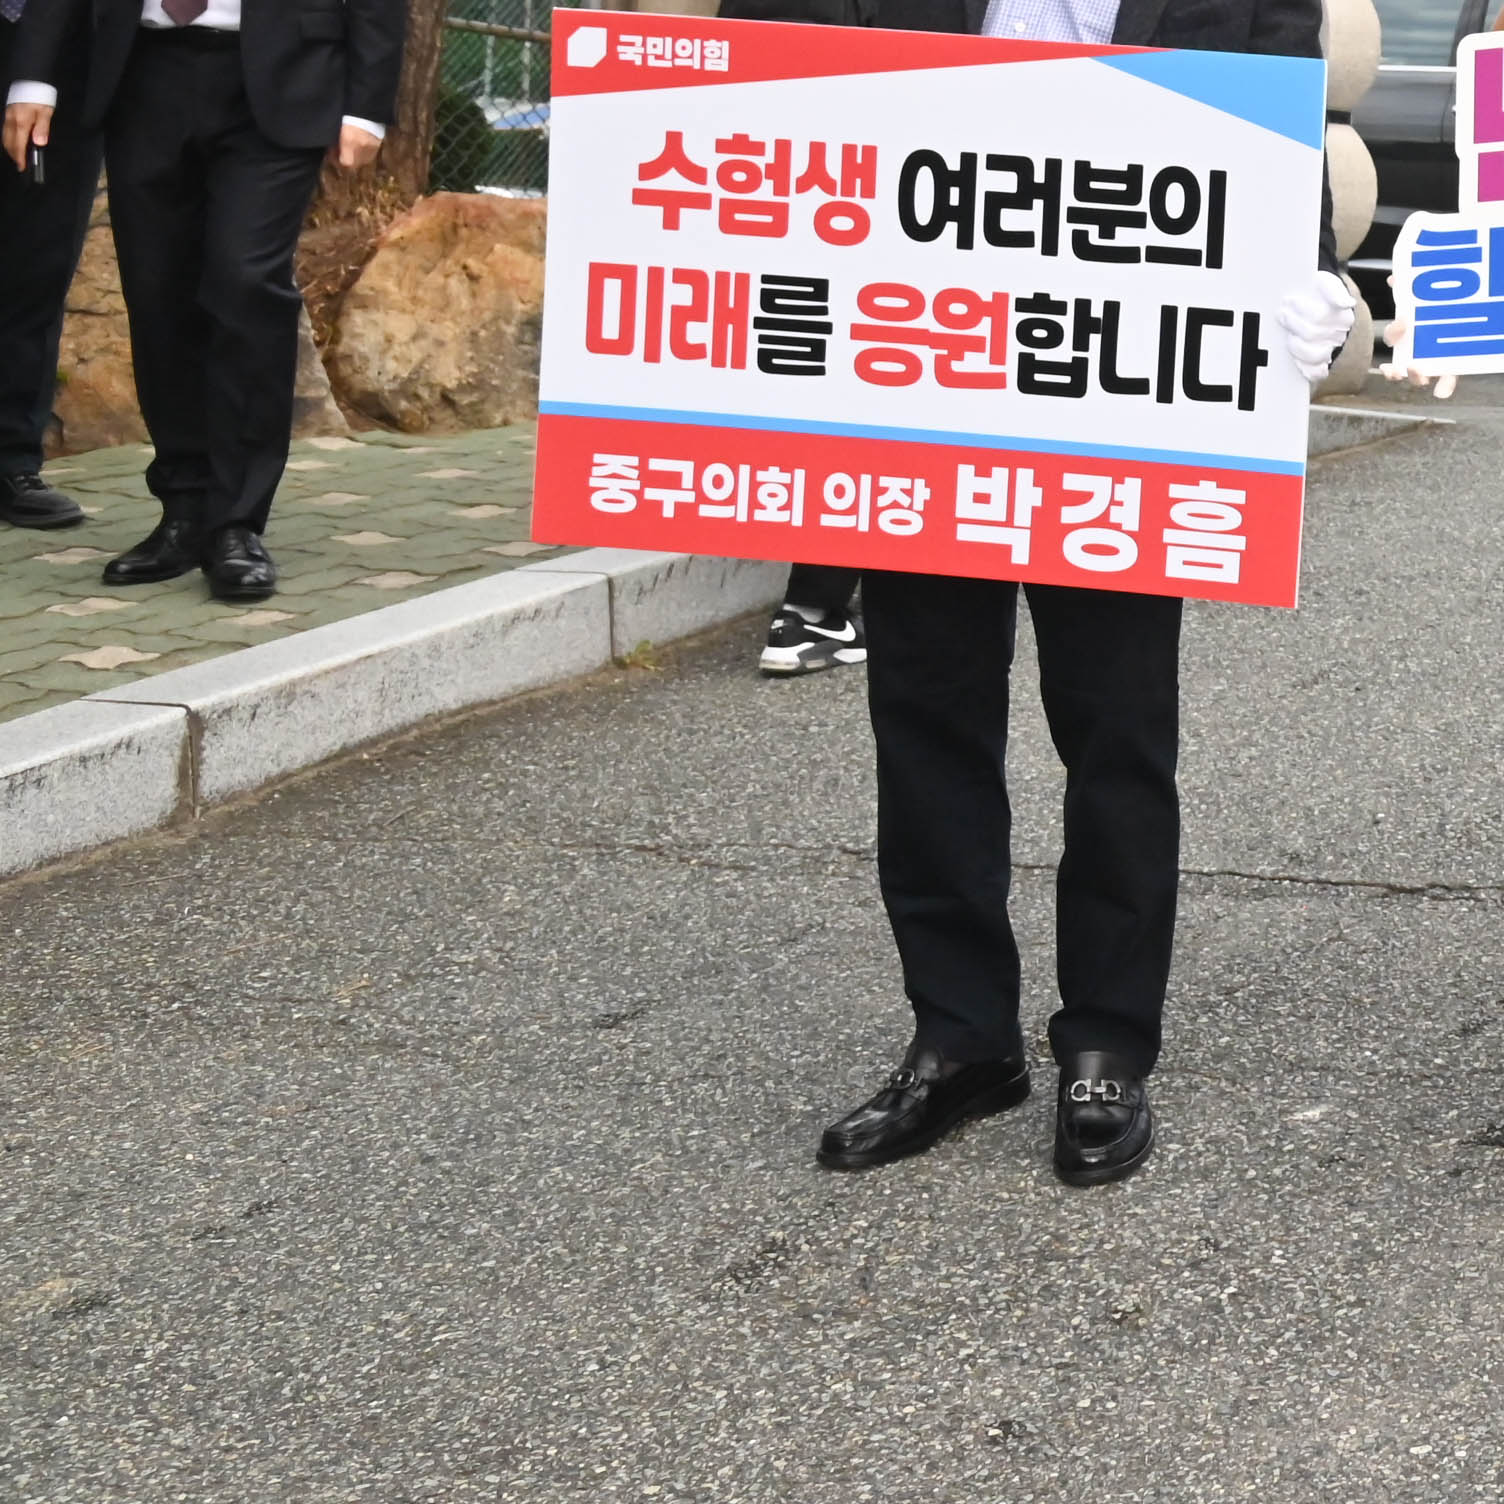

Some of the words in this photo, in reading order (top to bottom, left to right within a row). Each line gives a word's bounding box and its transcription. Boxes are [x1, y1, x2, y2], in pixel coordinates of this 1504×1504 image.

[618, 36, 728, 71] 국민의힘
[632, 131, 877, 246] 수험생
[898, 149, 1227, 269] 여러분의
[586, 262, 833, 376] 미래를
[850, 283, 1268, 411] 응원합니다
[590, 454, 805, 526] 중구의회
[821, 473, 930, 535] 의장
[956, 464, 1246, 583] 박경흠
